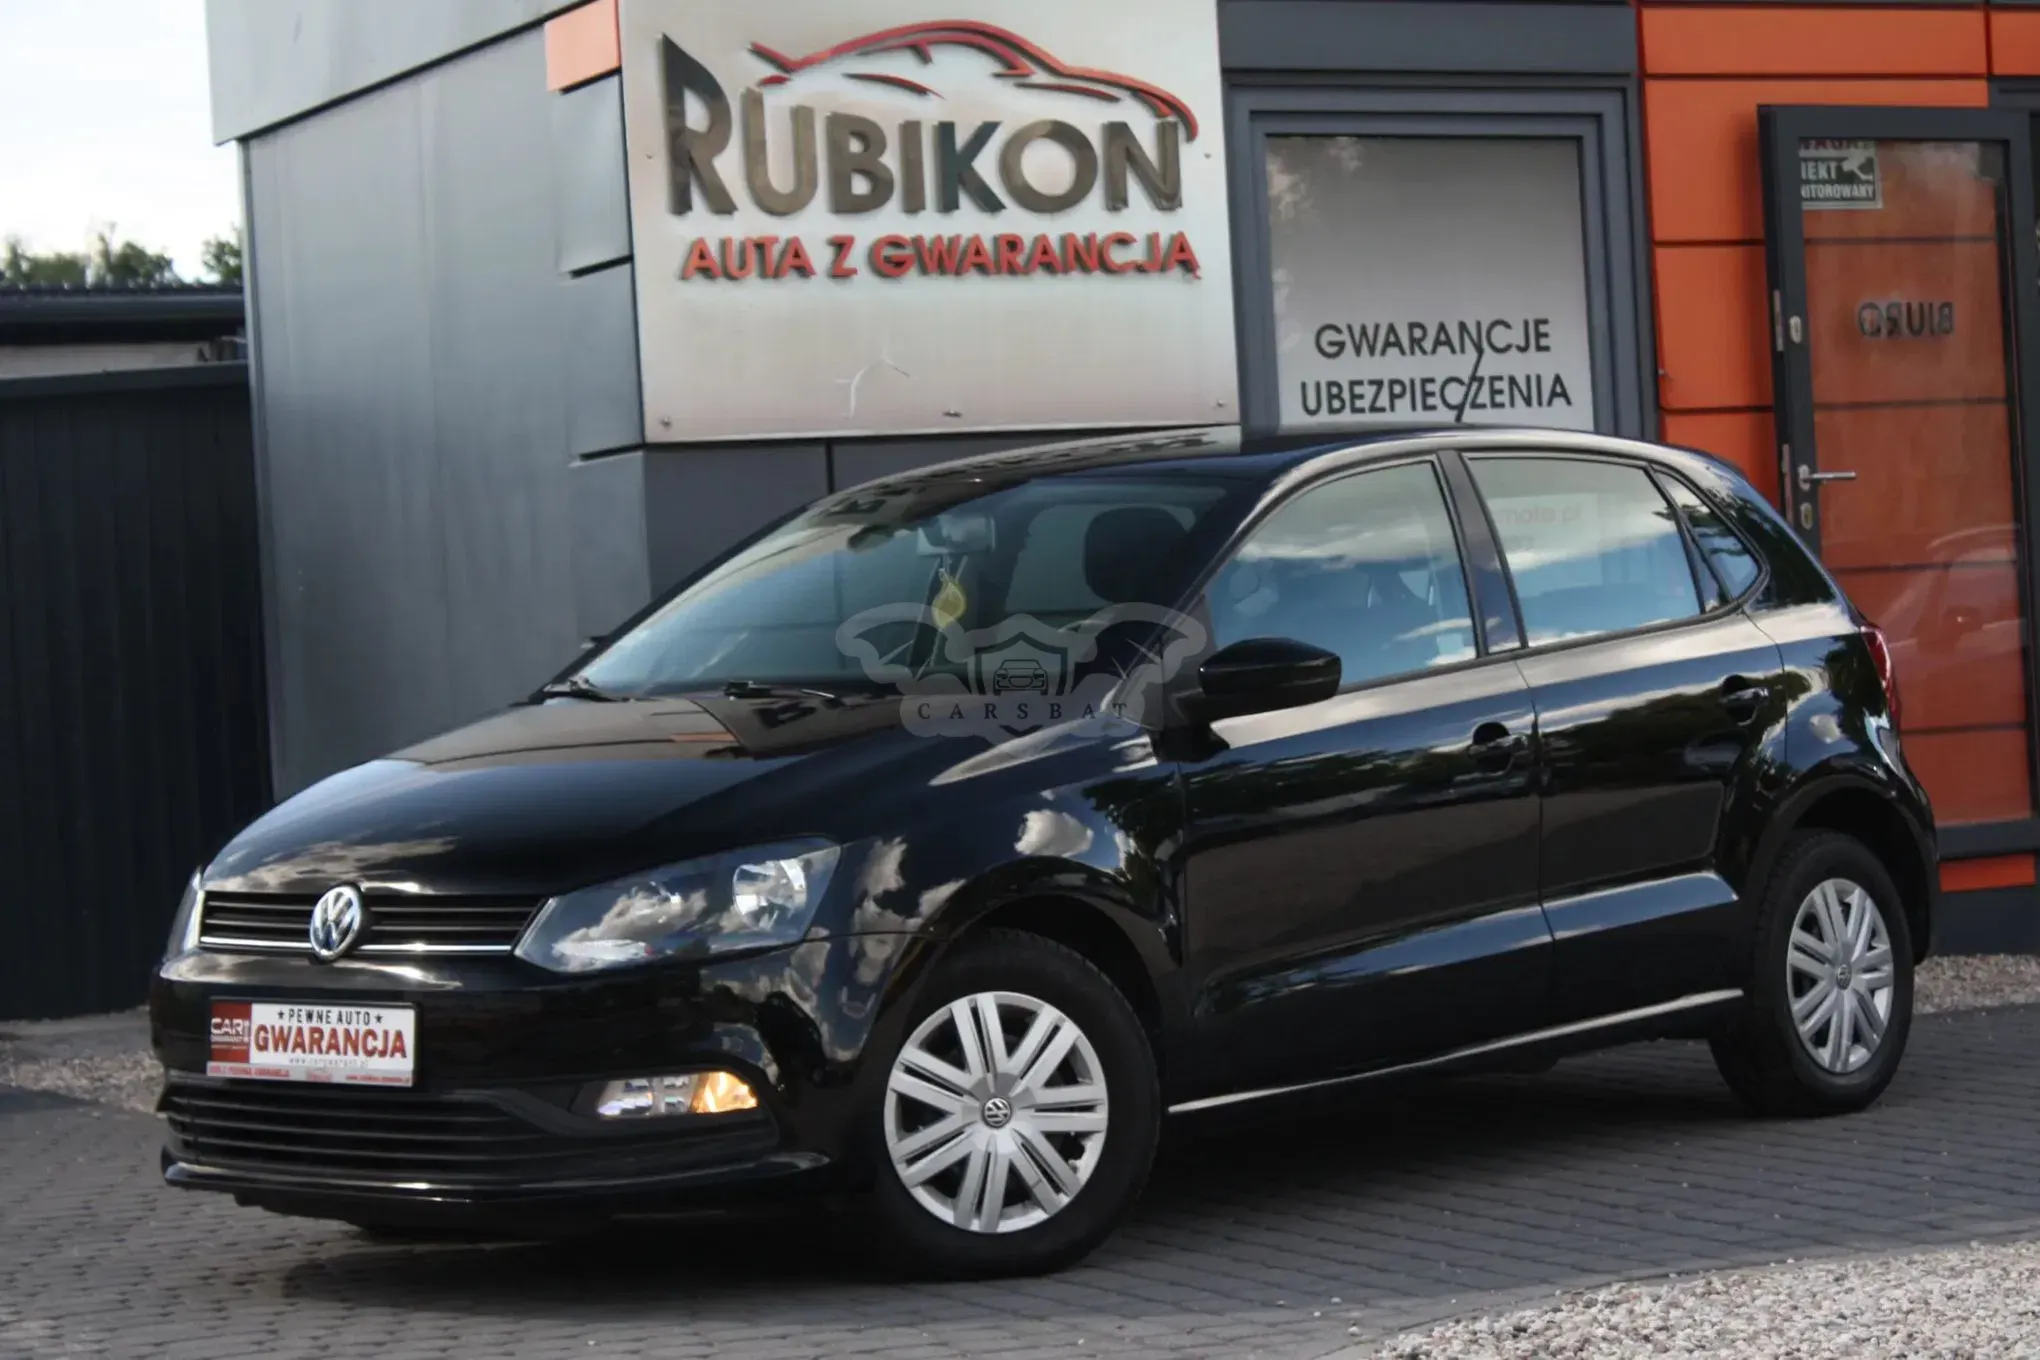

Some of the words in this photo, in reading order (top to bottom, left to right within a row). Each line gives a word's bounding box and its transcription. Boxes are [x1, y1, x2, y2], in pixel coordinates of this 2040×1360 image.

[661, 33, 1184, 217] RUBIKON
[681, 235, 816, 281] AUTA
[828, 234, 858, 279] Z
[1314, 317, 1552, 359] GWARANCJE
[1300, 373, 1573, 416] UBEZPIECZENIA
[287, 1008, 332, 1025] PEWNE
[336, 1010, 371, 1025] AUTO
[254, 1024, 408, 1059] GWARANCJA
